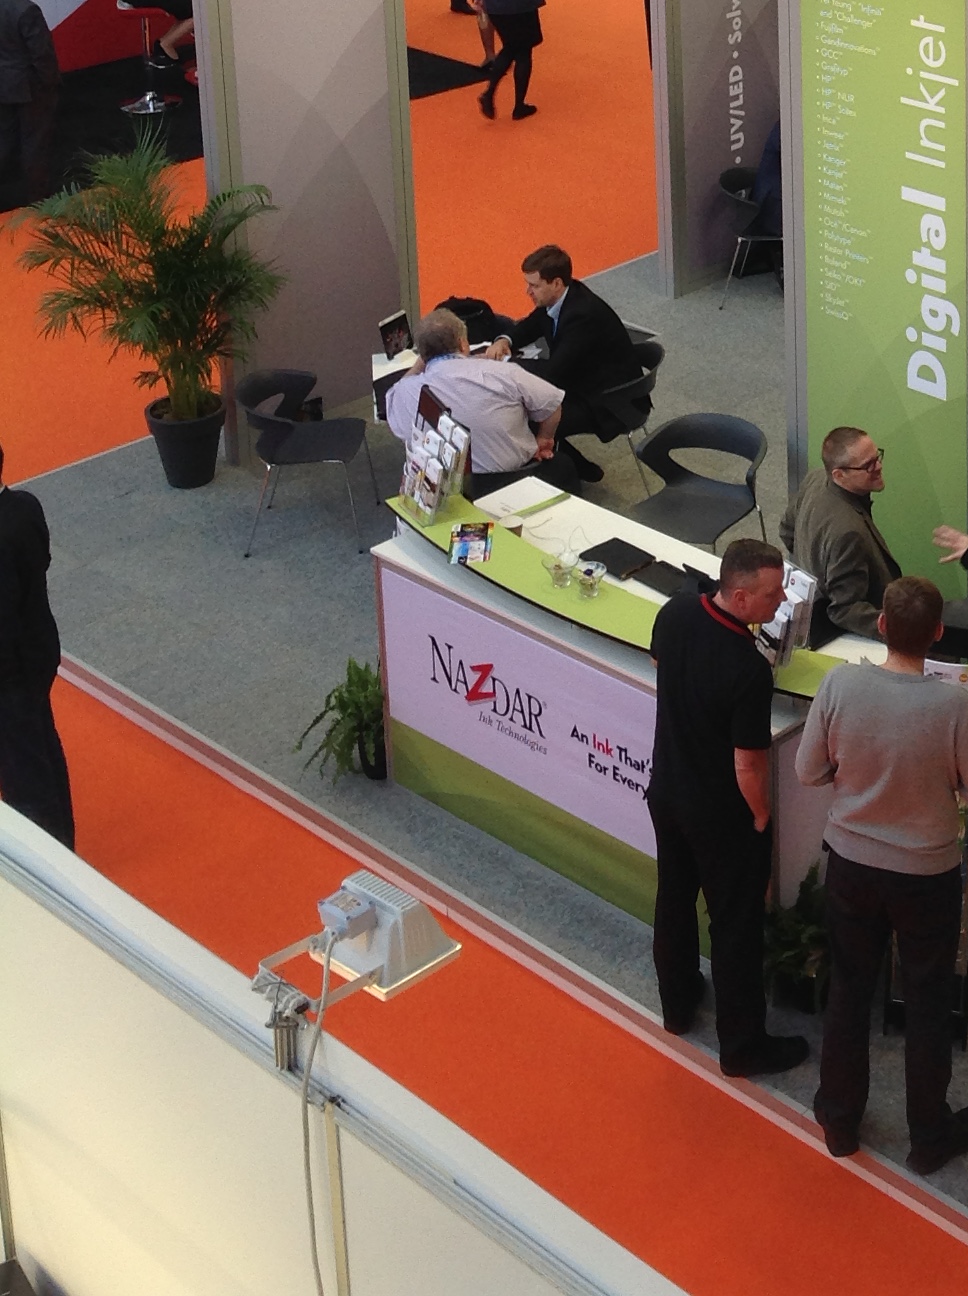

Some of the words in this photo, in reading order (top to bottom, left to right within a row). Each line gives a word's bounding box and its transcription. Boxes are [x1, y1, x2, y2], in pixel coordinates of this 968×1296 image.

[729, 65, 745, 151] UV/LED
[900, 15, 959, 168] Inkjet
[901, 185, 960, 401] Digital
[428, 634, 546, 739] NAZDAR
[478, 711, 494, 727] Ink
[496, 719, 548, 756] Technologies
[570, 725, 589, 746] An
[592, 733, 613, 758] Ink
[588, 754, 609, 776] For
